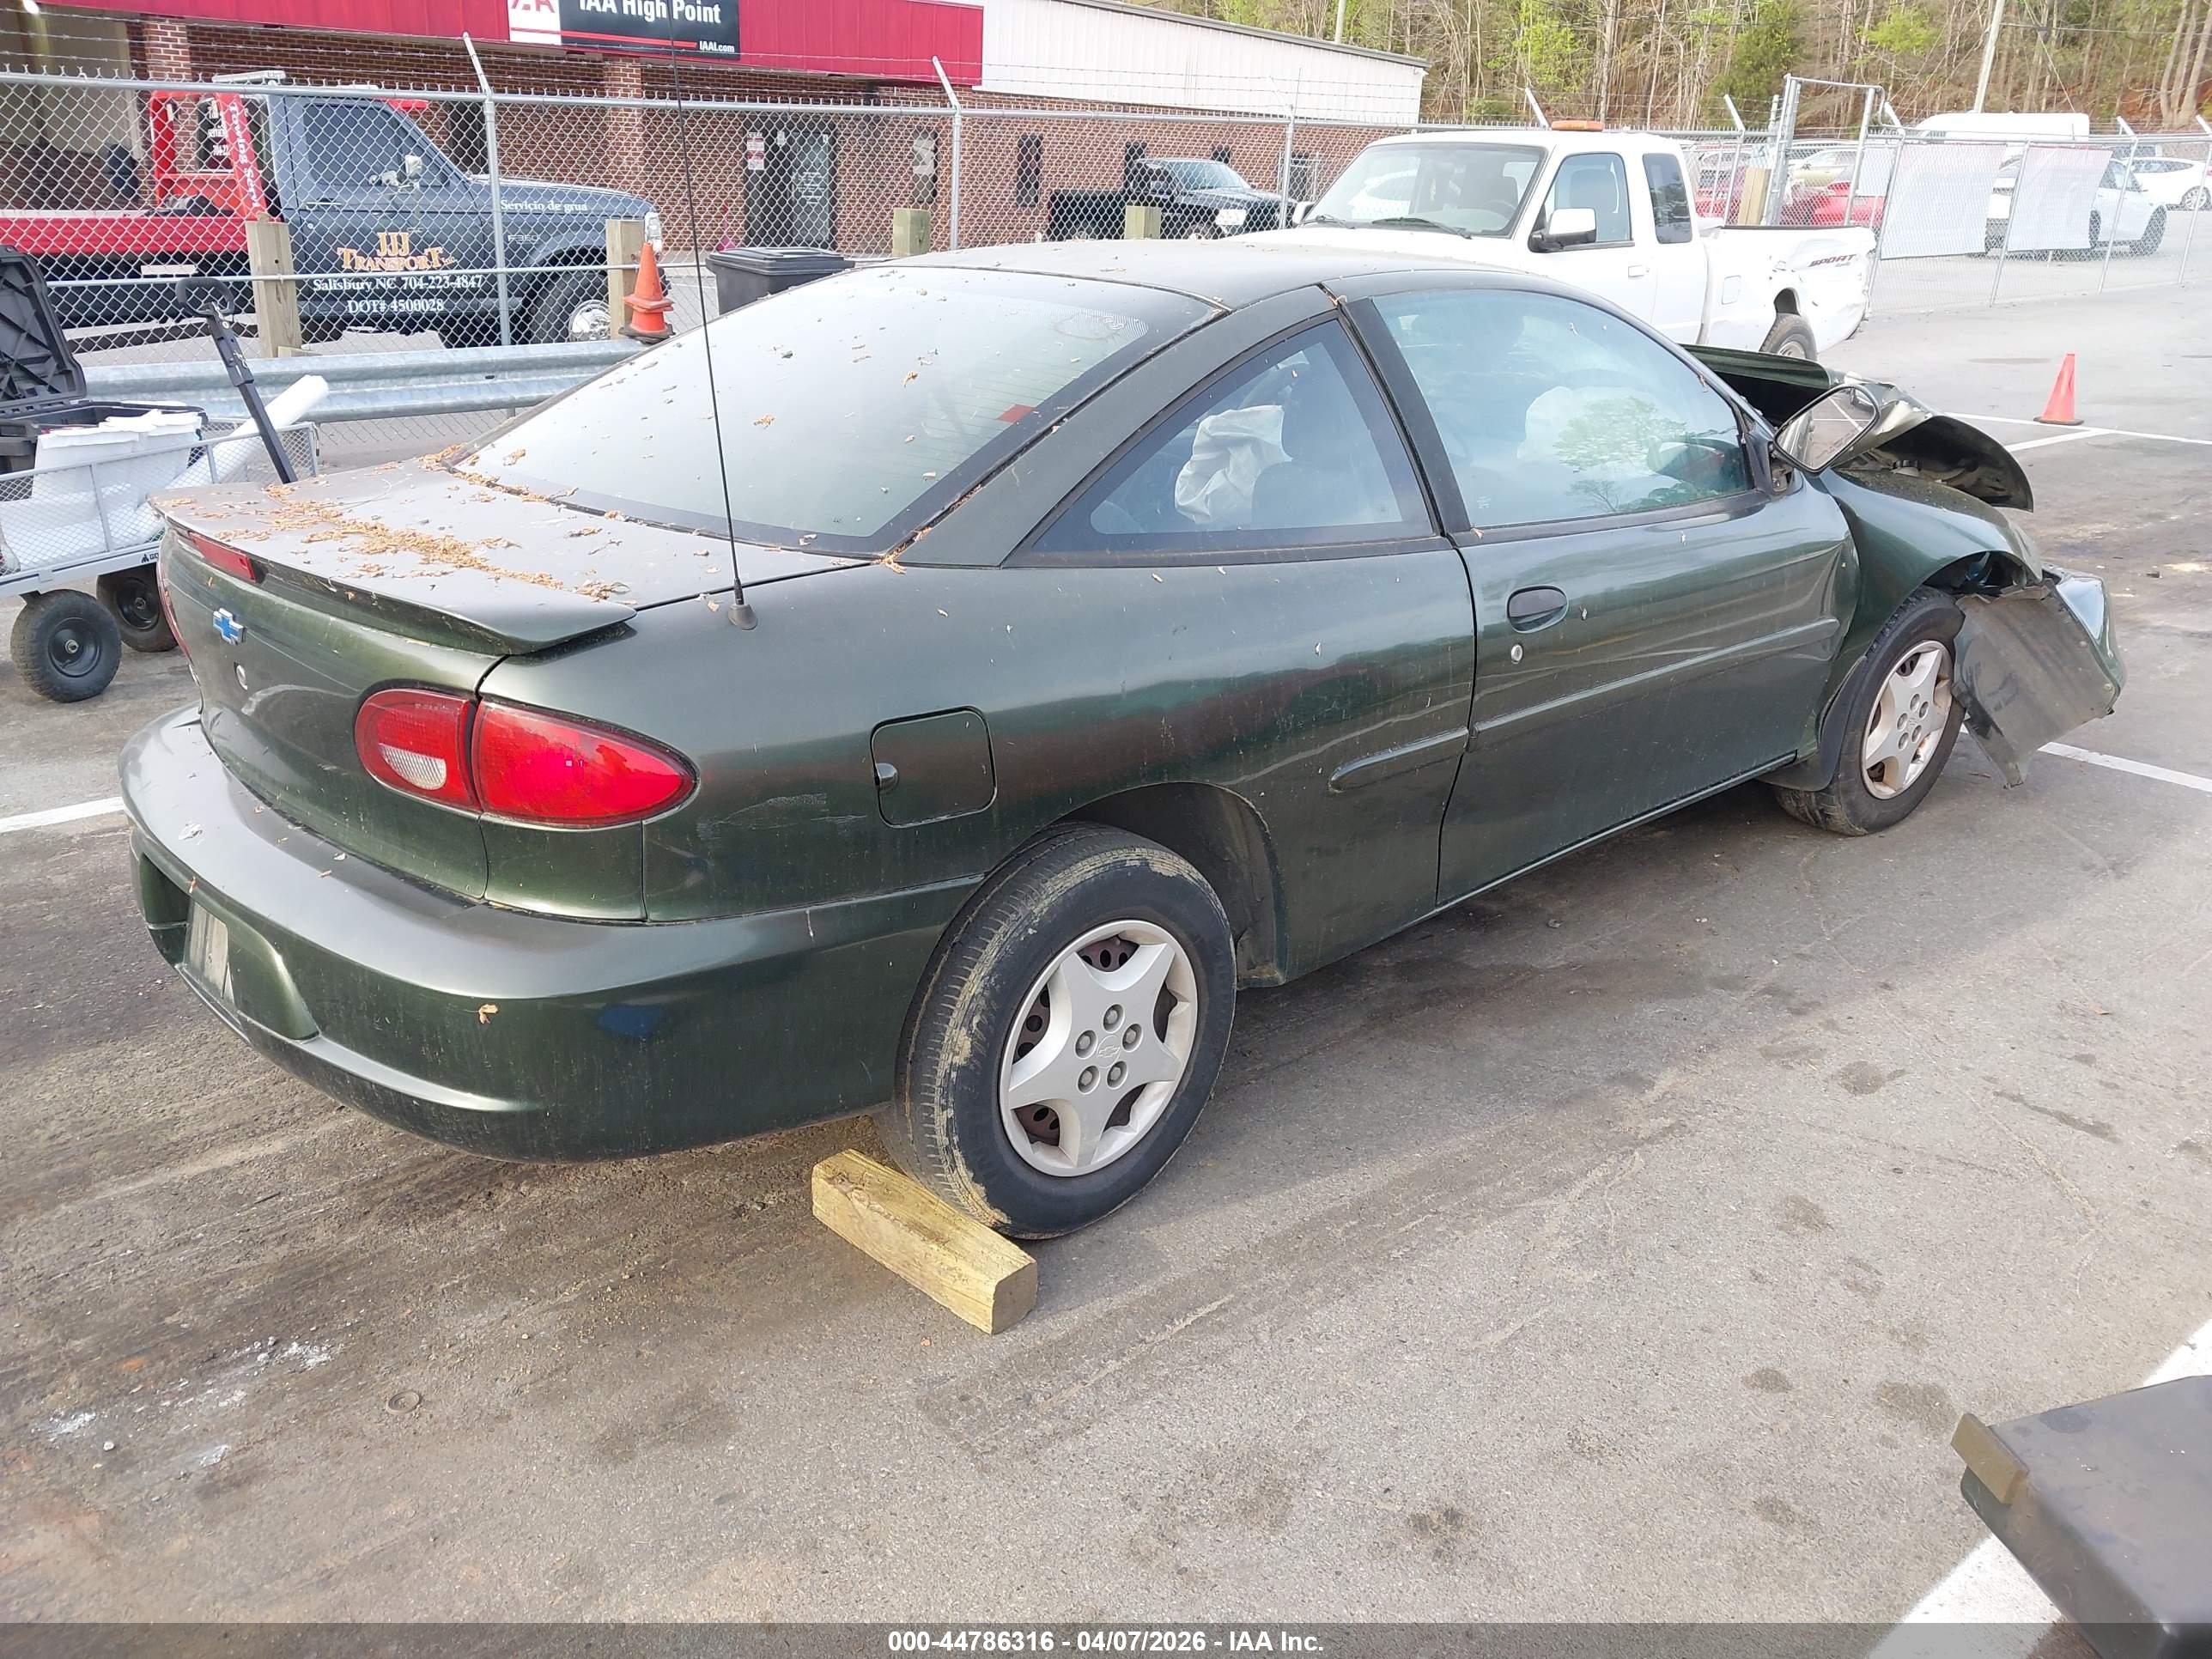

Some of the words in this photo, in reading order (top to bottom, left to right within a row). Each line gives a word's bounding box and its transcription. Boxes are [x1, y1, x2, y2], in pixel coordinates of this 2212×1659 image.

[623, 0, 666, 21] High
[672, 0, 721, 23] Point
[229, 102, 248, 164] Towing
[501, 199, 545, 211] Servicio
[547, 199, 562, 211] de
[563, 200, 588, 213] grua
[377, 231, 410, 257] JJJ
[1807, 253, 1856, 267] SPORT
[313, 276, 372, 293] Salisbury
[375, 277, 397, 289] NC
[401, 274, 483, 290] 704-223-4847
[347, 299, 386, 313] DOT#
[390, 298, 445, 313] 4500028
